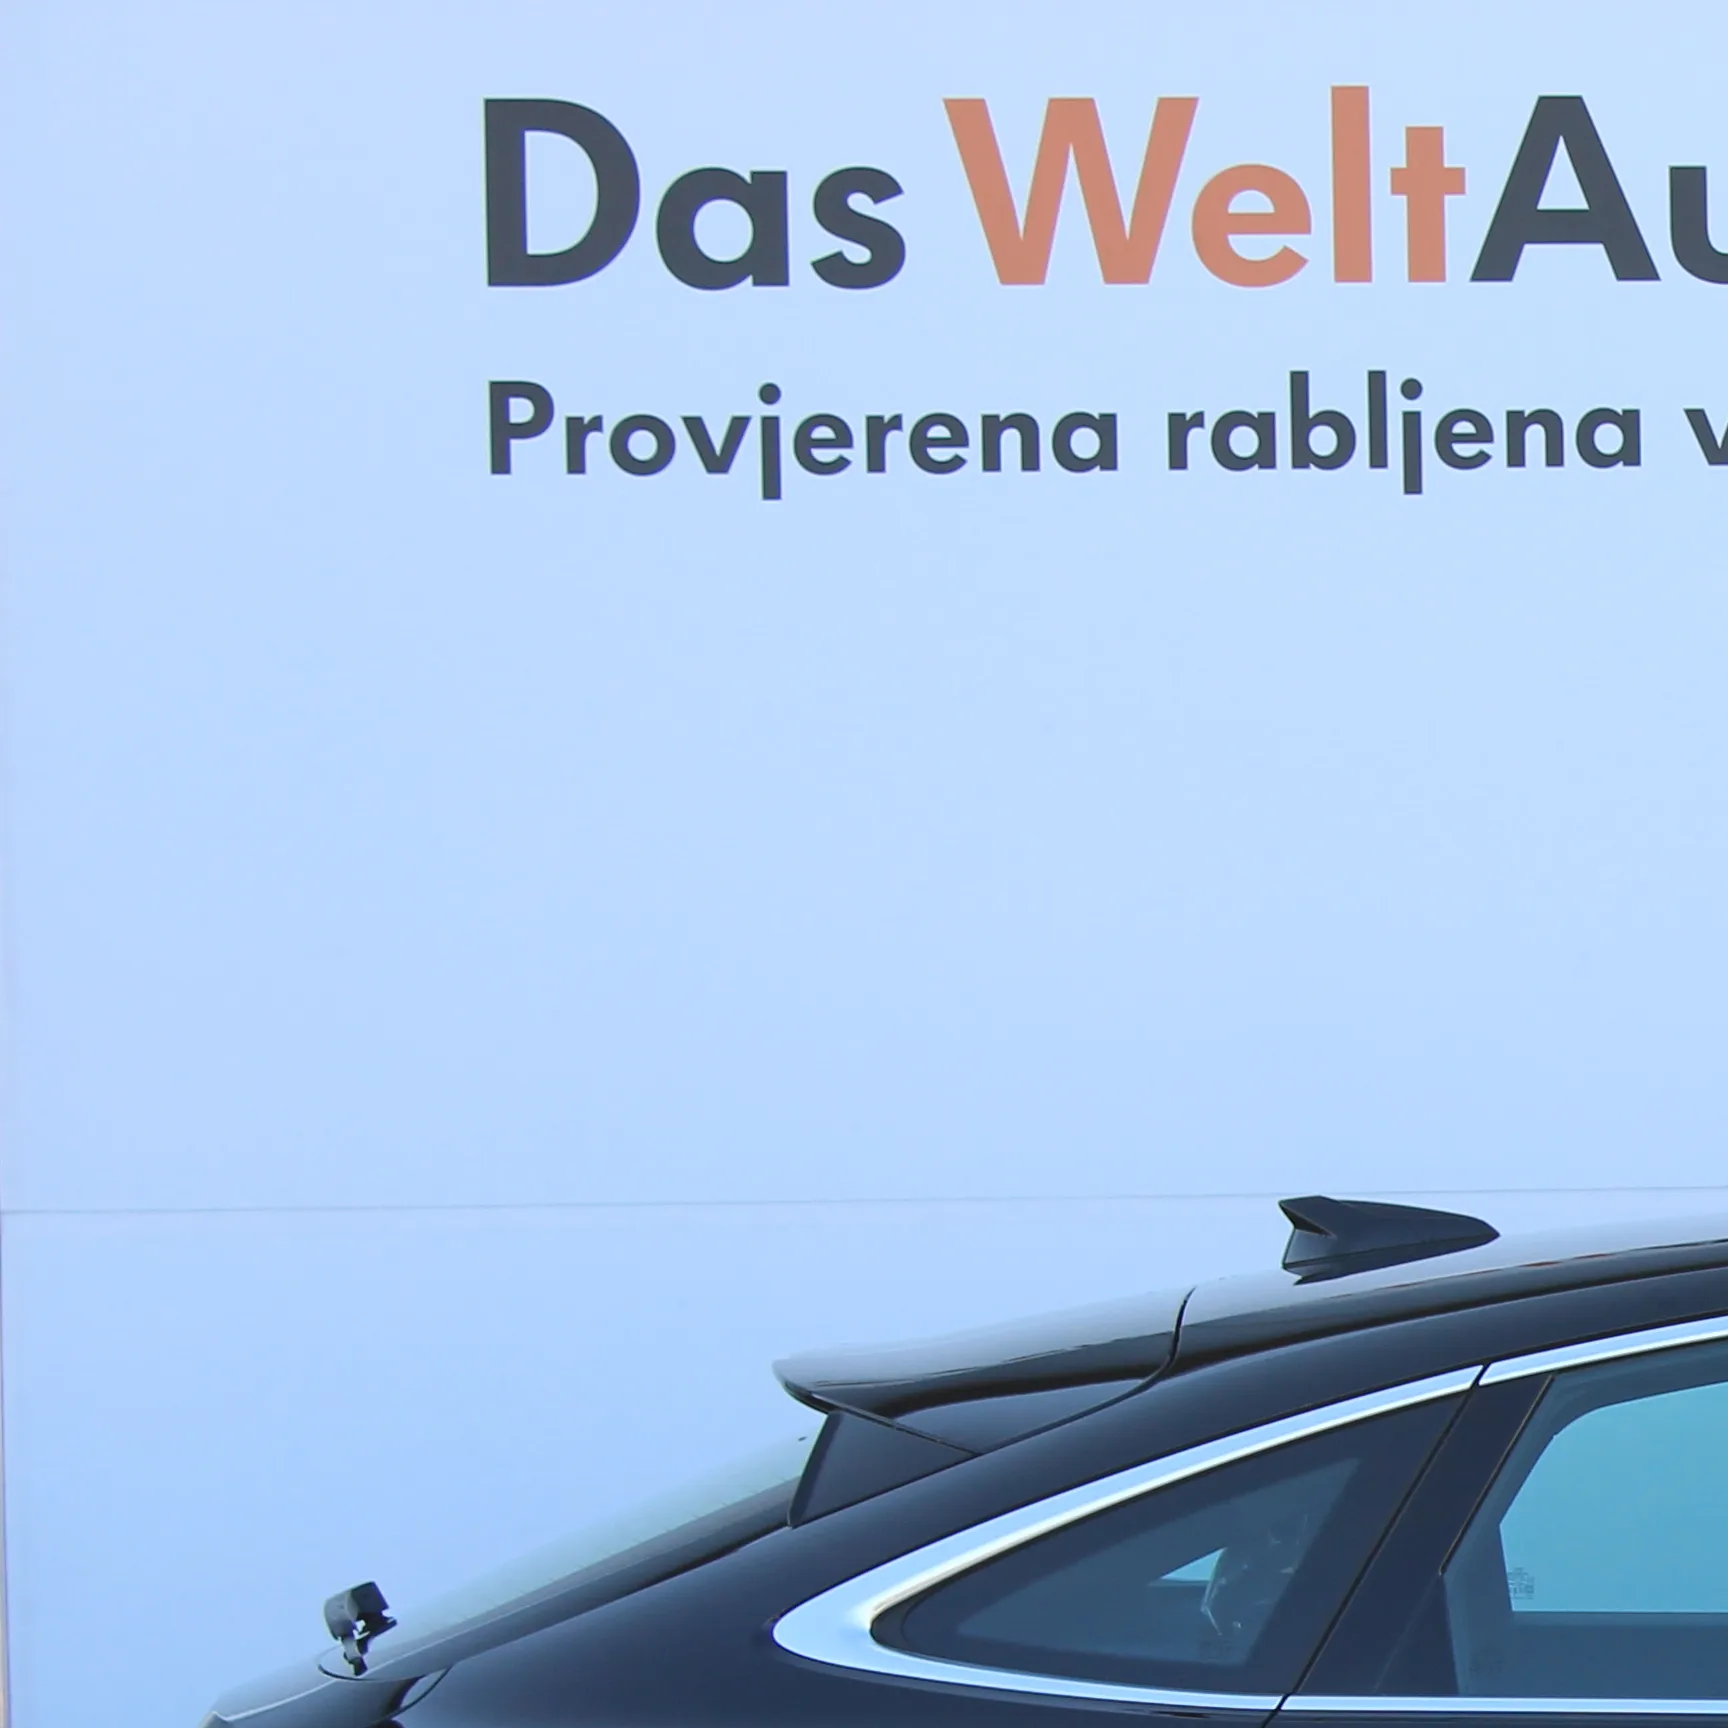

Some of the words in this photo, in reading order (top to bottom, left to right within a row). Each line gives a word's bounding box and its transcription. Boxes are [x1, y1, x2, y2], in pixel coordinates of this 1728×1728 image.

[484, 97, 906, 290] Das
[488, 381, 1118, 501] Provjerena
[1167, 369, 1641, 495] rabljena
